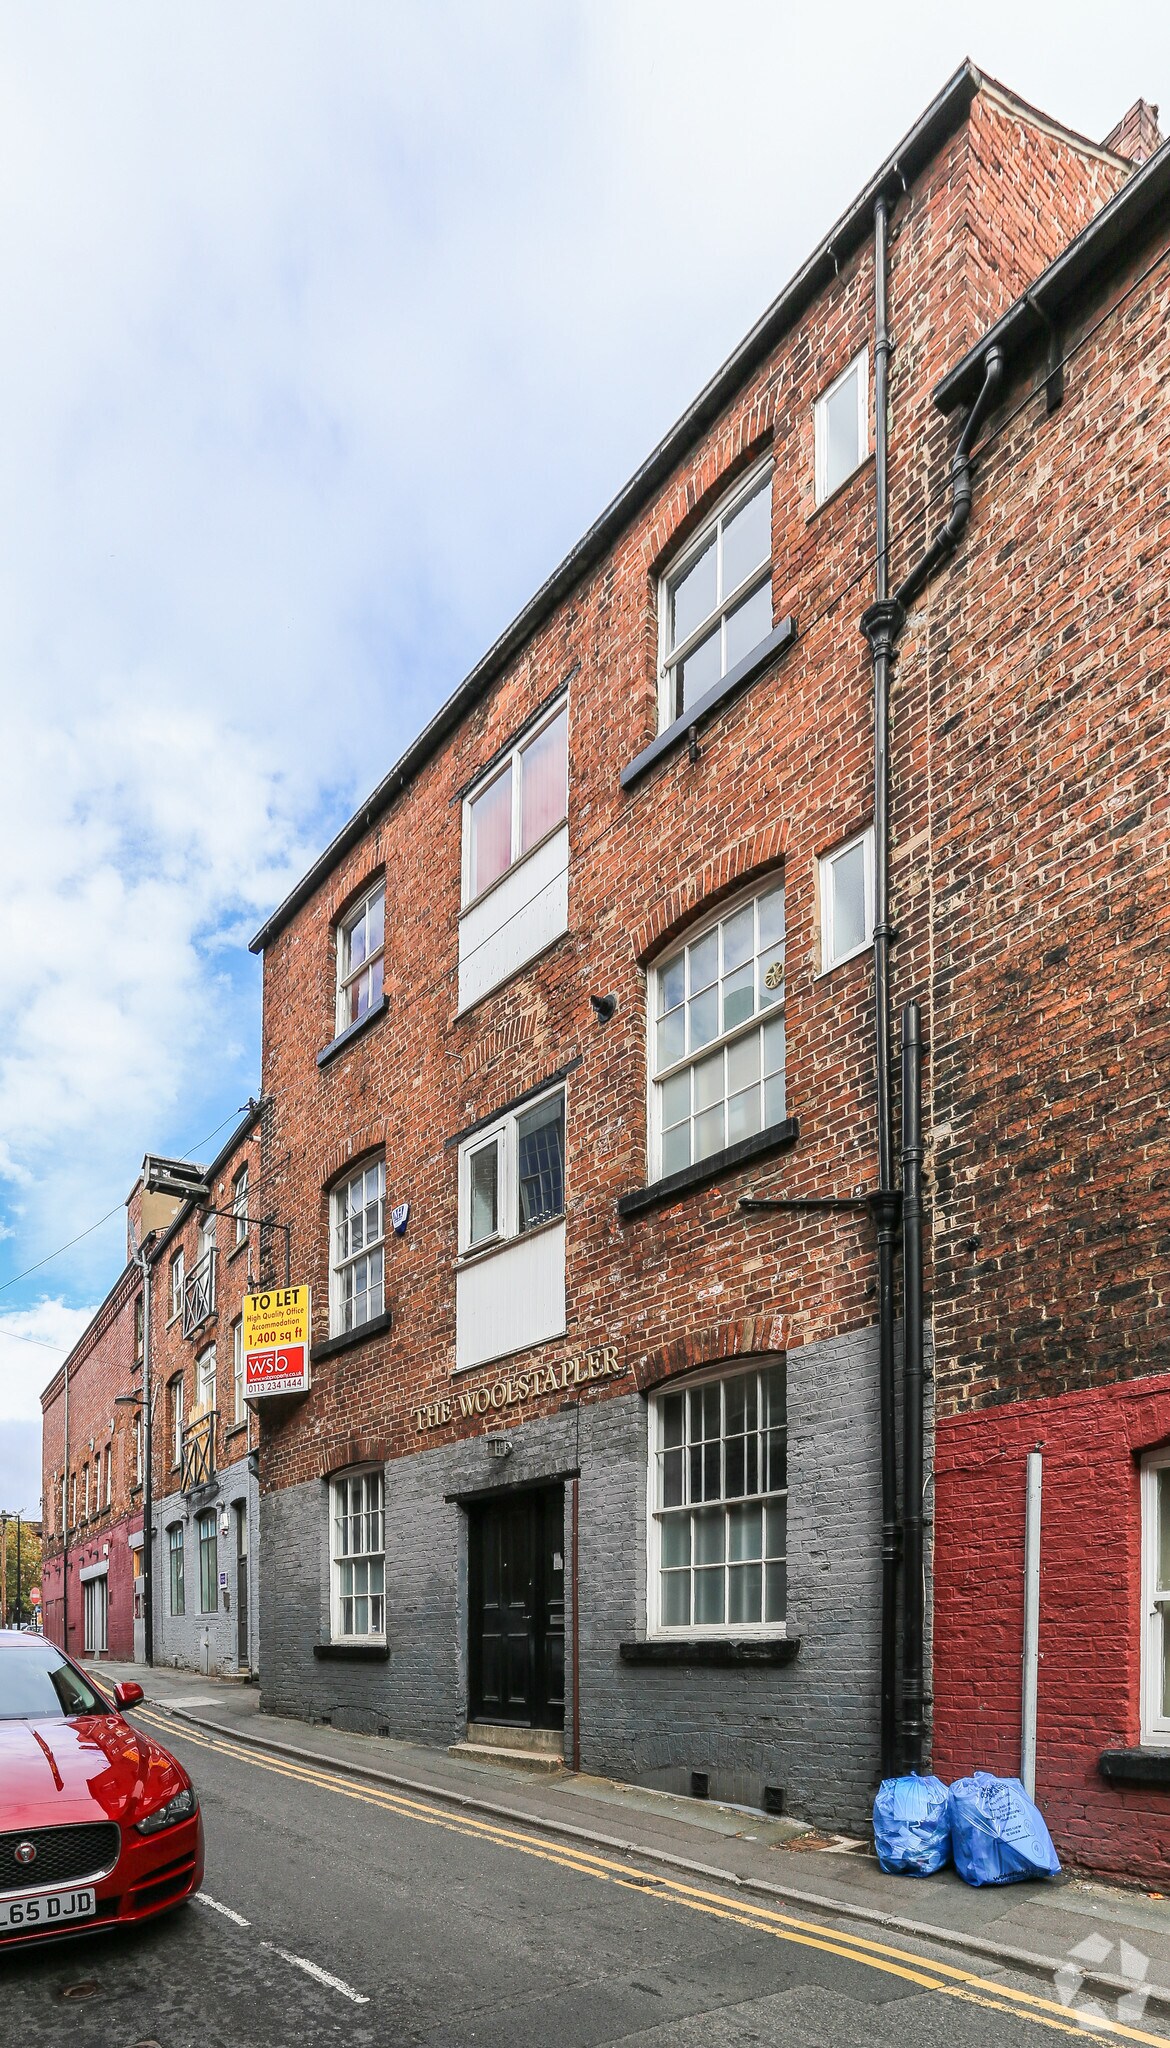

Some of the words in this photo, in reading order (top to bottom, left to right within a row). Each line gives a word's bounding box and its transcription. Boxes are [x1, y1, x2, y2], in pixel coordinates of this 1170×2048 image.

[251, 1294, 271, 1312] TO
[276, 1288, 300, 1307] LET
[246, 1313, 261, 1323] High
[262, 1310, 285, 1320] Quality
[286, 1307, 304, 1316] Office
[251, 1318, 300, 1331] Accommodation
[248, 1331, 277, 1347] 1,400
[279, 1331, 292, 1342] sq
[294, 1326, 303, 1338] ft
[248, 1350, 288, 1376] wsb
[248, 1383, 265, 1393] 0113
[267, 1381, 282, 1391] 234
[283, 1379, 302, 1389] 1444
[411, 1399, 453, 1433] THE
[457, 1345, 625, 1418] WOOLSTAPLER
[46, 1892, 91, 1918] DJD
